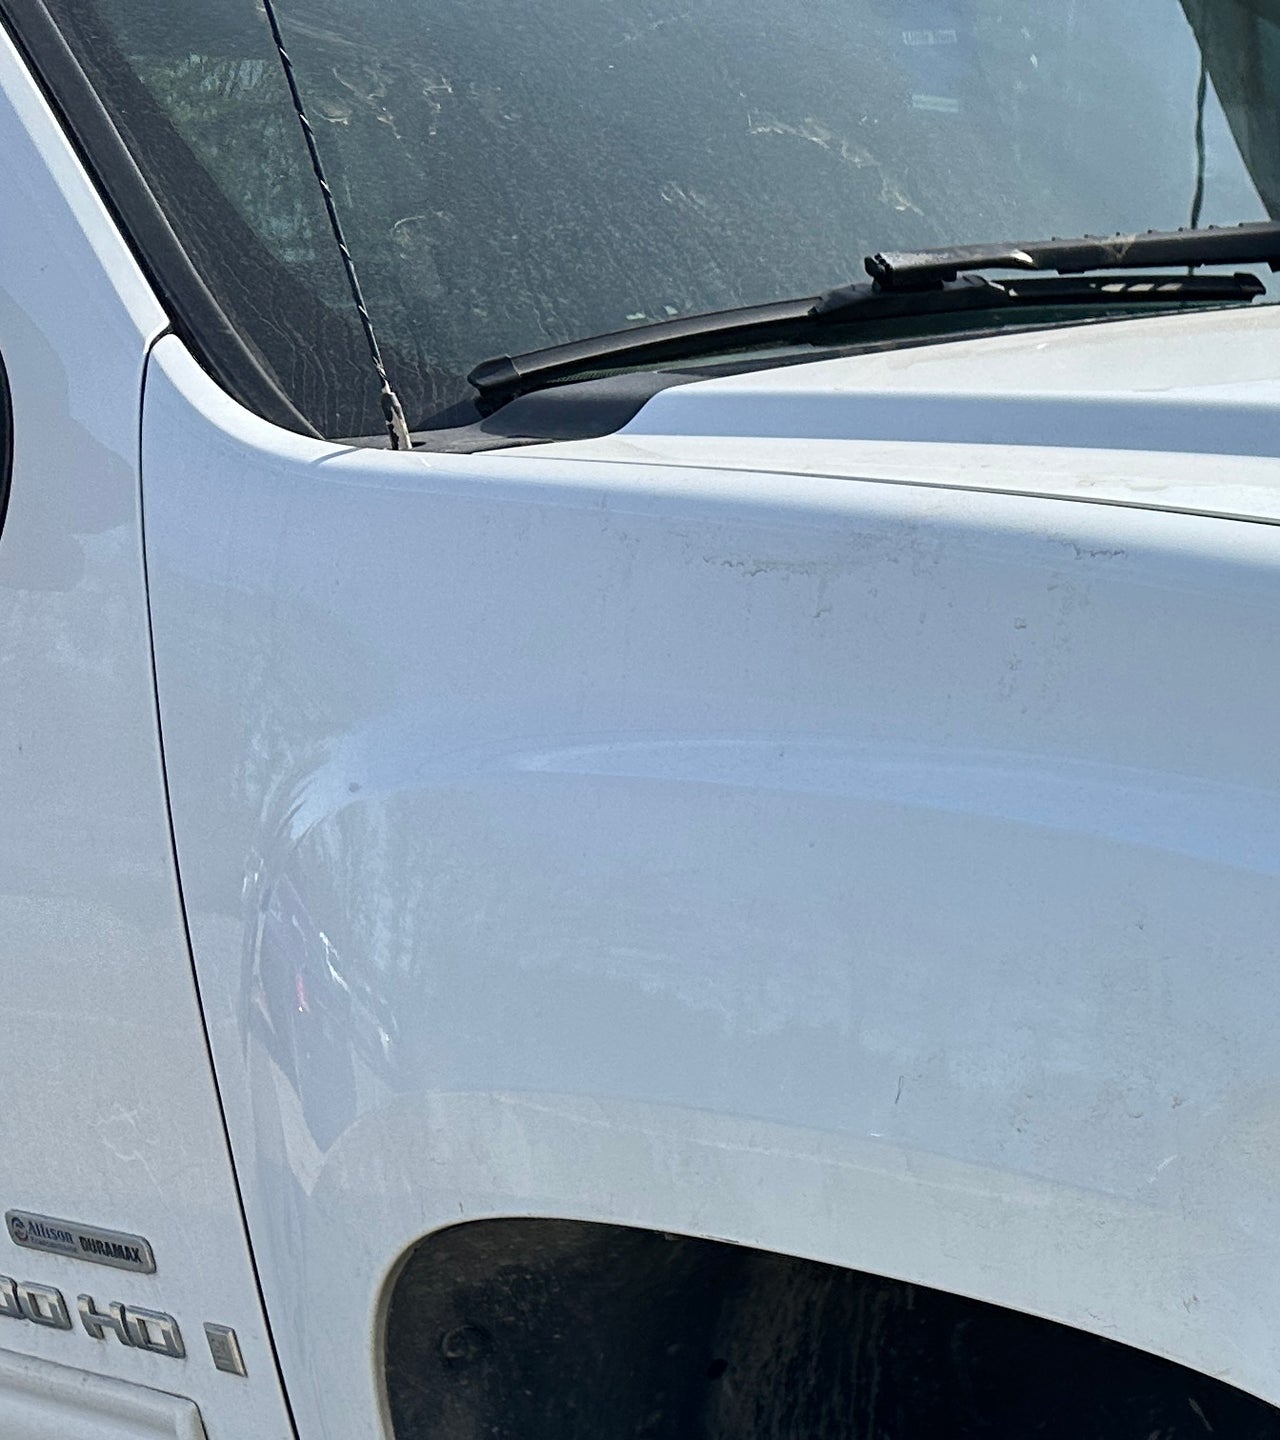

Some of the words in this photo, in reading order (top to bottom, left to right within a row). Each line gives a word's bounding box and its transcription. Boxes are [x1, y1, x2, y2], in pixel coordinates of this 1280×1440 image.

[28, 1220, 75, 1245] Allison
[78, 1235, 143, 1264] DURAMAX
[77, 1293, 187, 1359] HD
